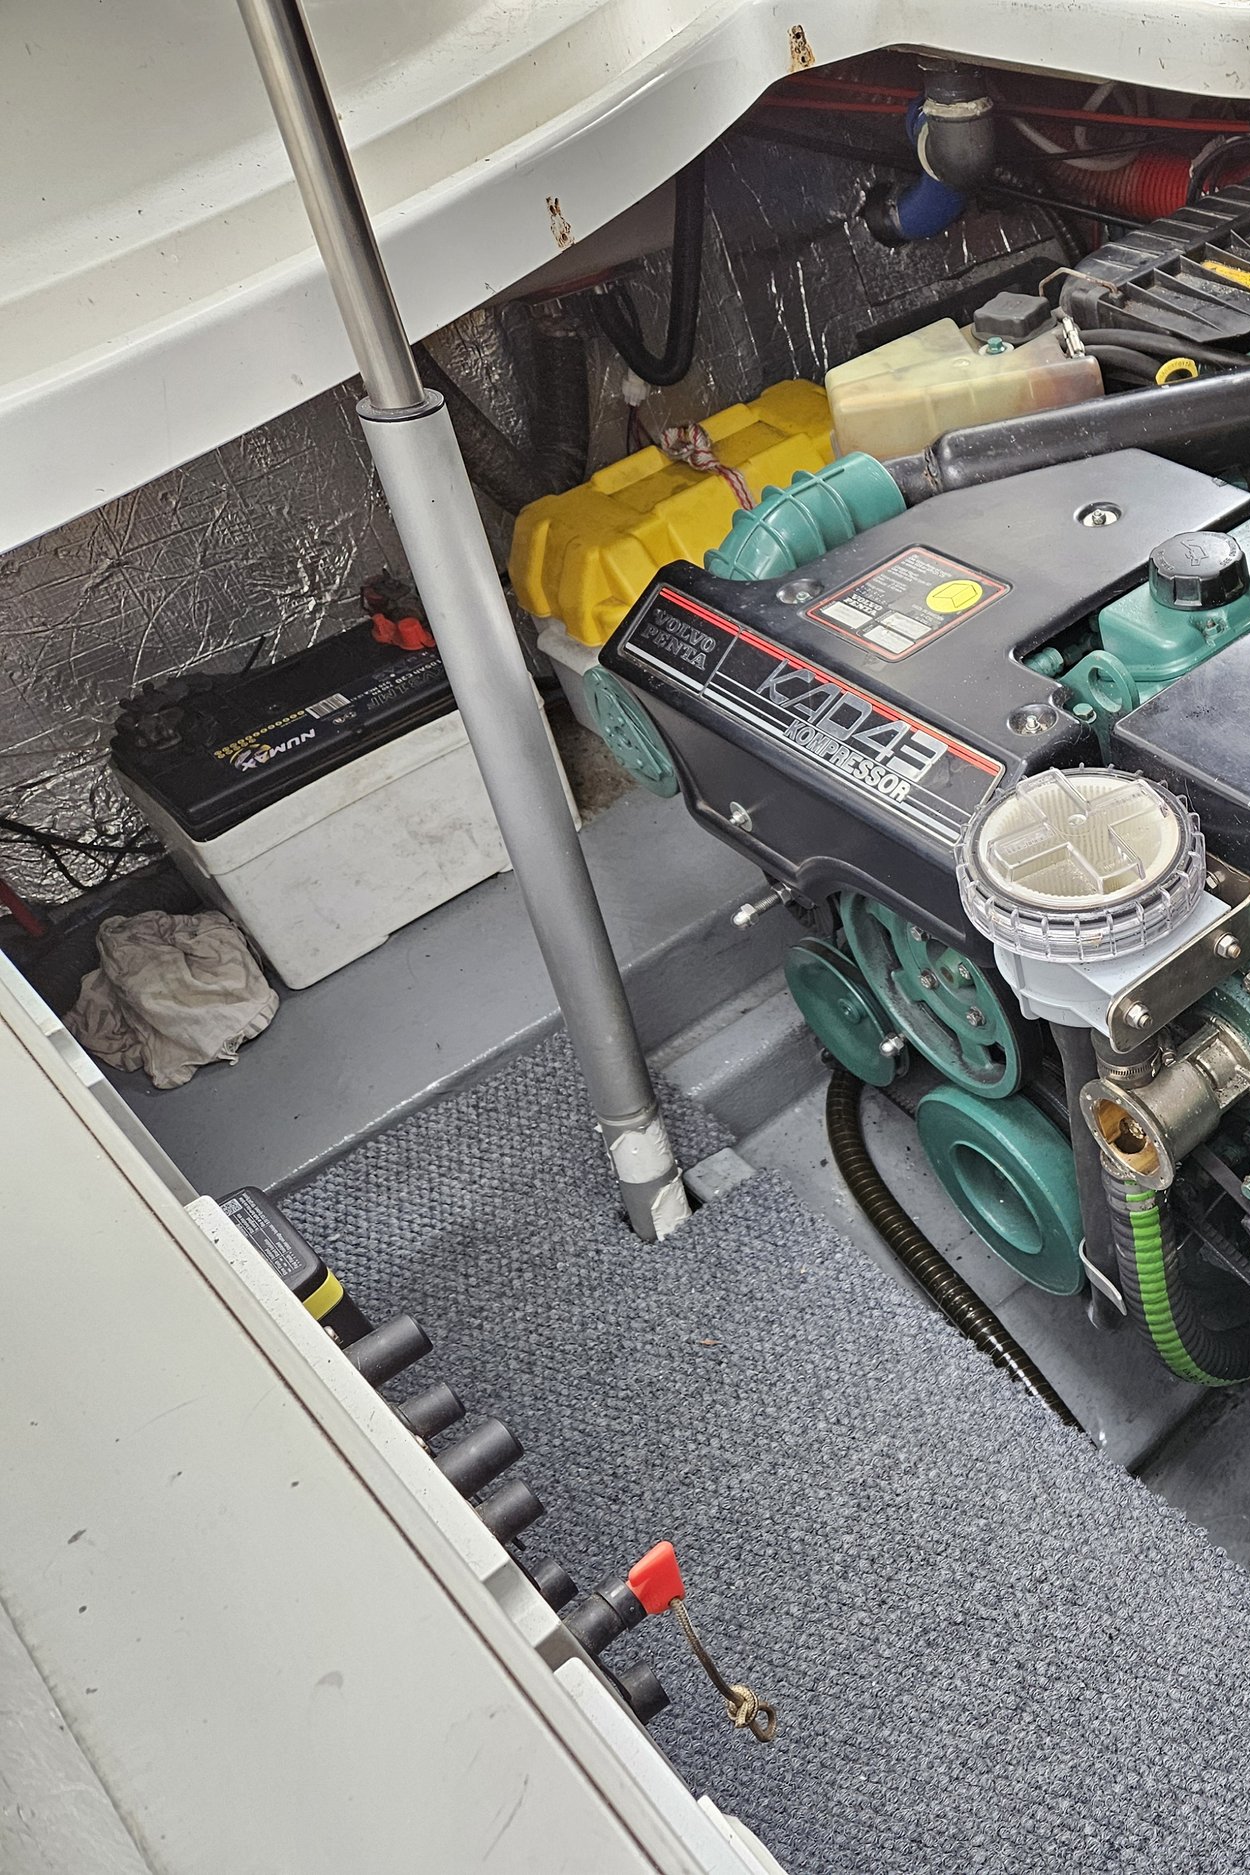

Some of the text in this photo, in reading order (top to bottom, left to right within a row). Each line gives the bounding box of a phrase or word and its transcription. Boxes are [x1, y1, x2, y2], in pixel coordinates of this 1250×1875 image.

[843, 597, 878, 617] PENTA
[850, 593, 884, 612] VOLVO
[640, 623, 707, 672] PENTA
[652, 607, 717, 653] VOLVO
[241, 728, 316, 772] NUMAX
[782, 719, 912, 804] KOMPRESSOR
